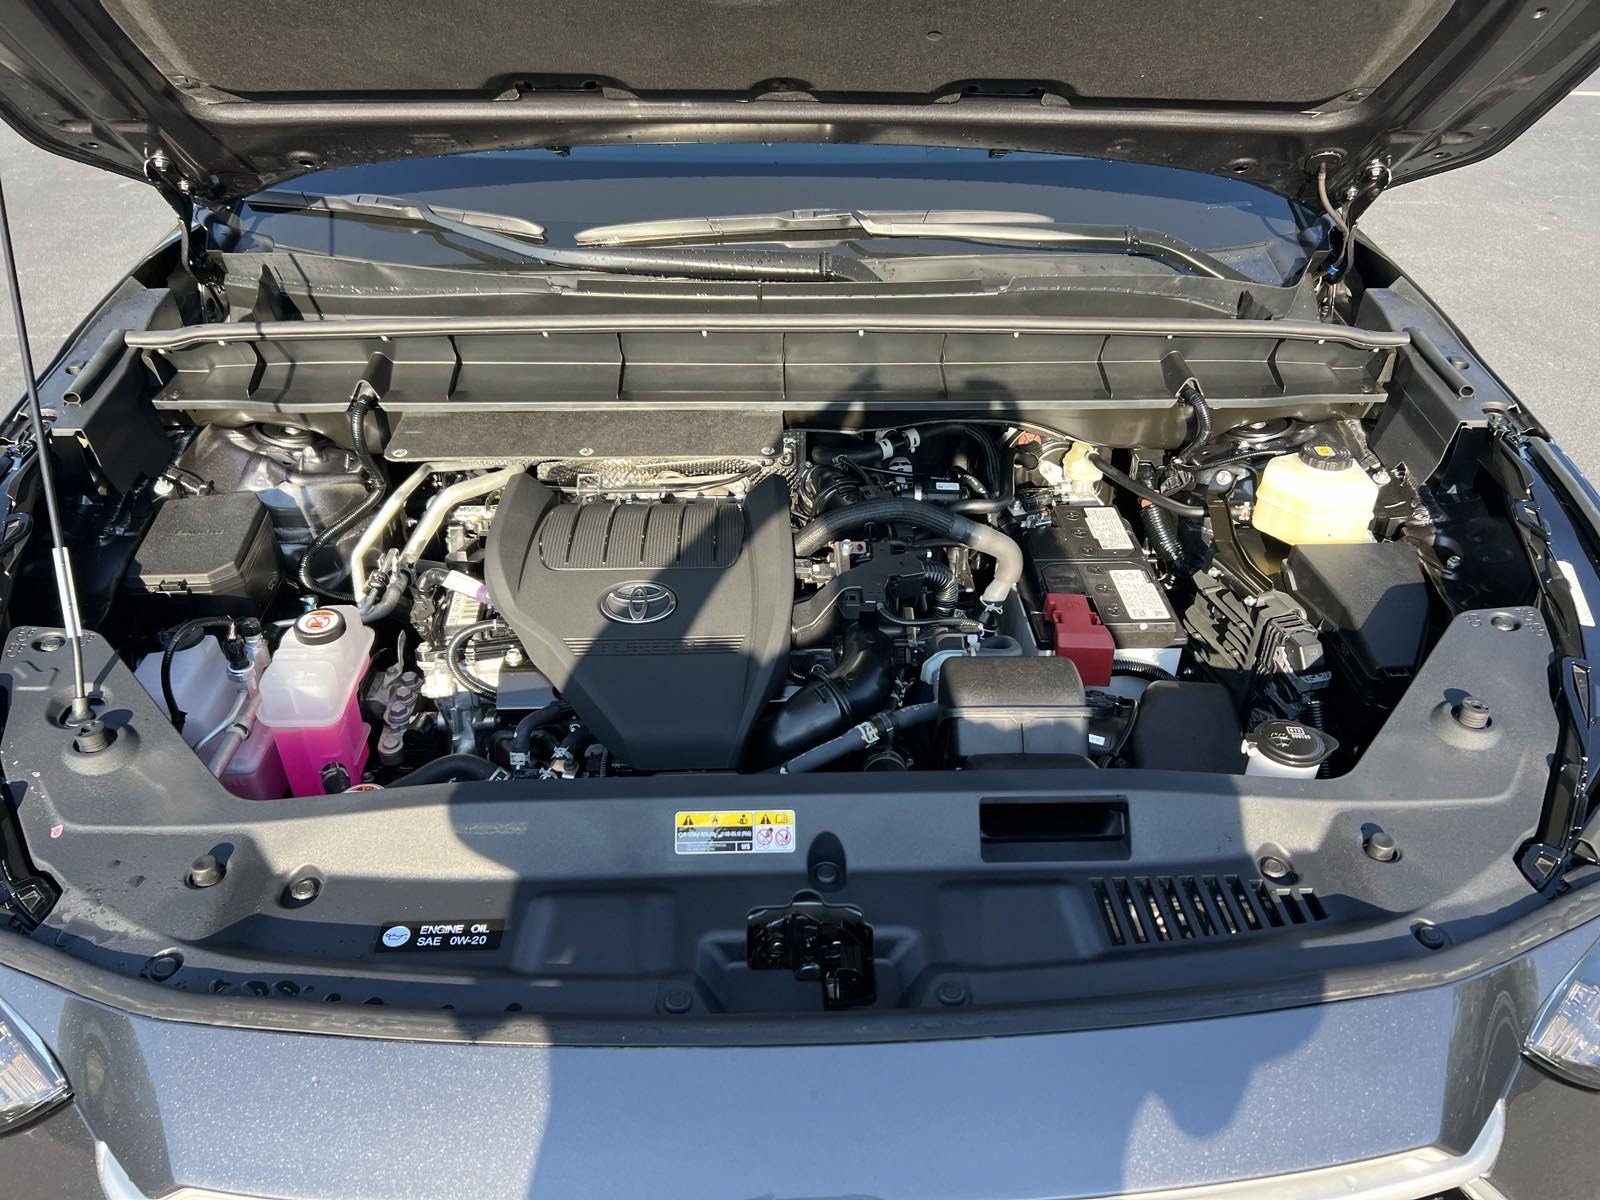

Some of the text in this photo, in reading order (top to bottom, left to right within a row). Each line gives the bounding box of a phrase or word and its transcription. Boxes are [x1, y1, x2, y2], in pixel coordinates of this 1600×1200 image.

[419, 923, 490, 935] ENGINE OIL
[416, 935, 487, 946] SAE 0W-20
